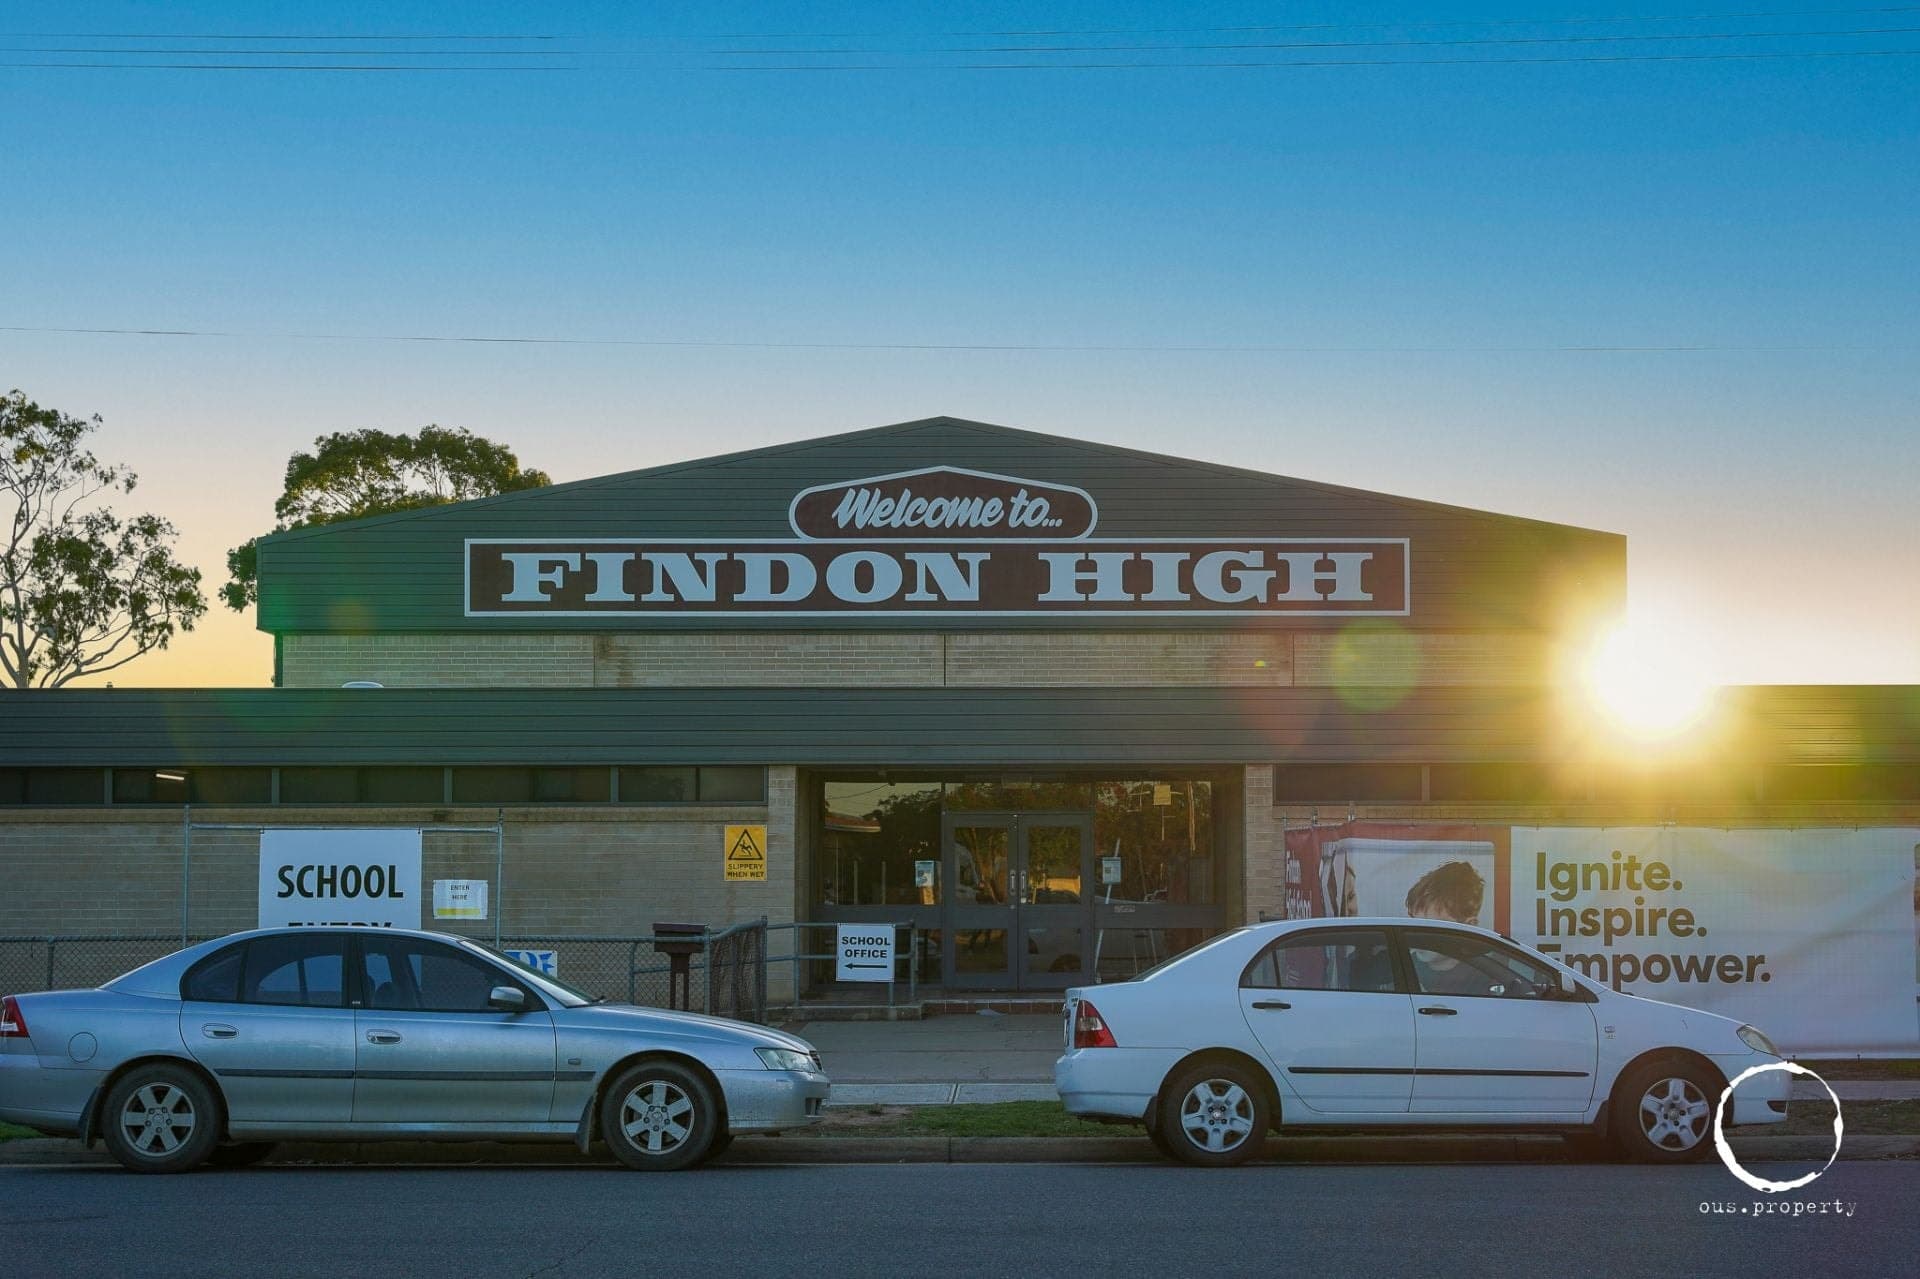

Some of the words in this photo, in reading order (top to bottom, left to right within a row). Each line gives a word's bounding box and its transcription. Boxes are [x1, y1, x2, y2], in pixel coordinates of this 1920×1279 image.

[832, 488, 1003, 529] Welcome
[1008, 488, 1063, 528] to...
[501, 551, 991, 602] FINDON
[1038, 550, 1373, 603] HIGH
[277, 865, 403, 898] SCHOOL
[1536, 850, 1683, 901] Ignite.
[841, 936, 891, 946] SCHOOL
[1536, 896, 1707, 947] Inspire.
[844, 949, 888, 959] OFFICE
